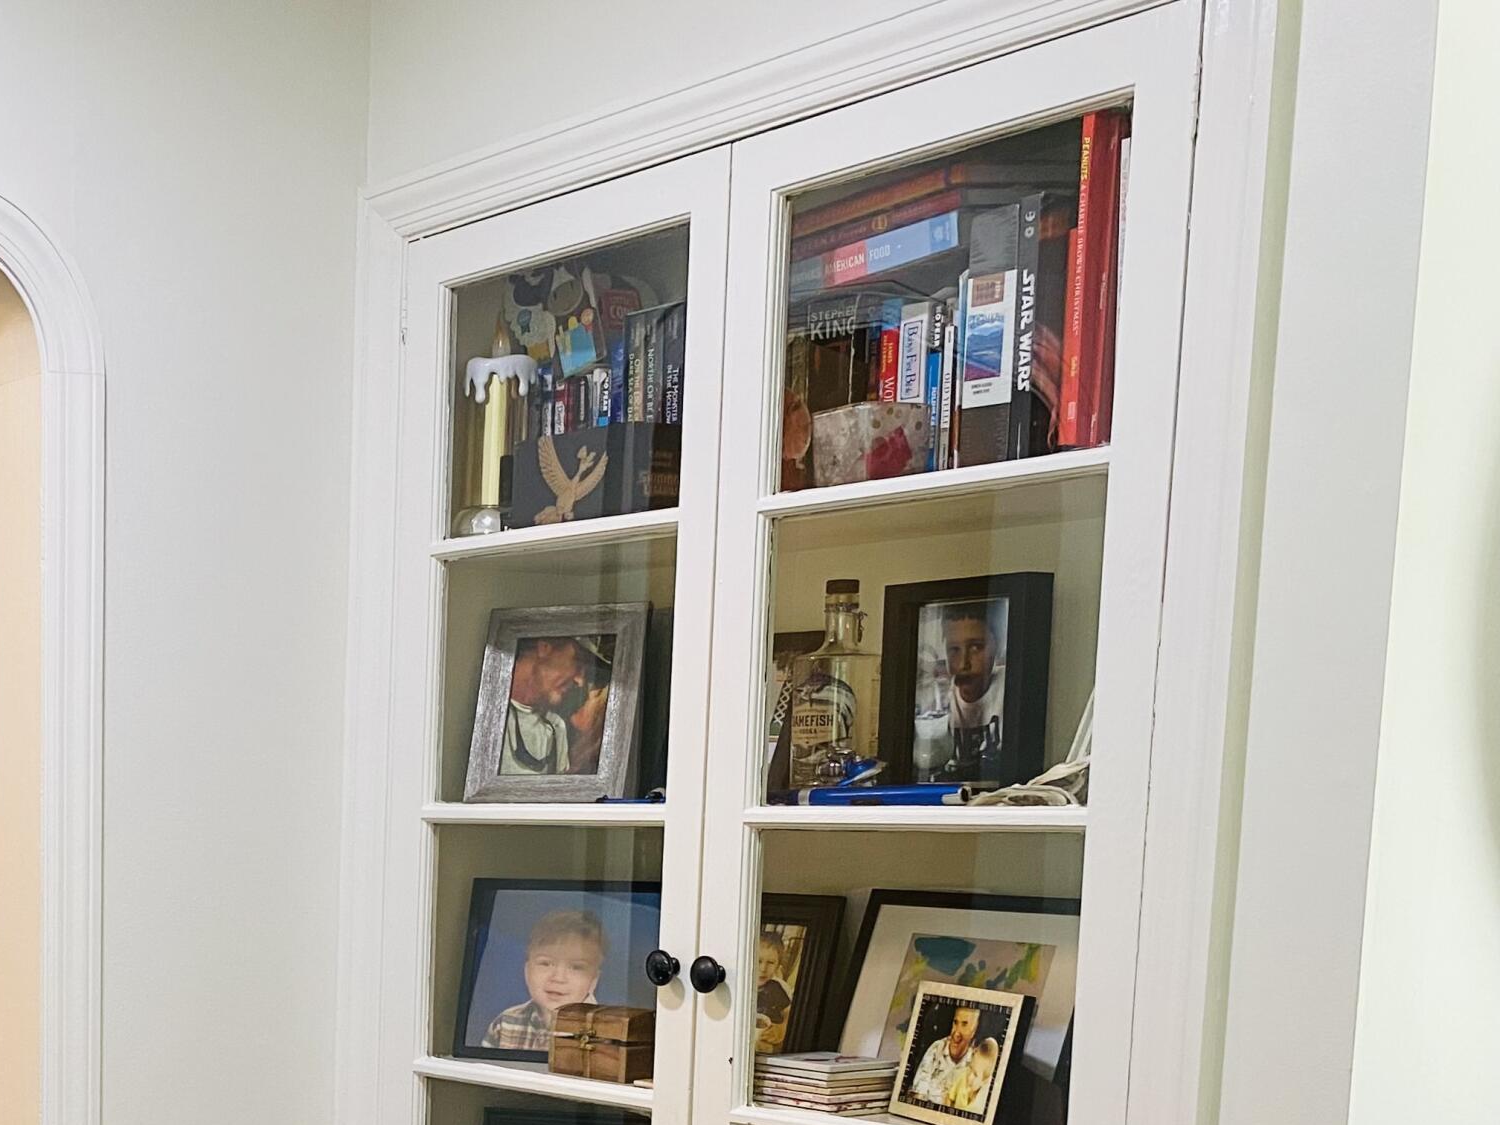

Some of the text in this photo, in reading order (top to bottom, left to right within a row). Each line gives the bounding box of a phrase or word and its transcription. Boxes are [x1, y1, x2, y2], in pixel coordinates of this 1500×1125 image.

[1080, 137, 1091, 180] PEANUTS
[868, 245, 891, 261] FOOD
[810, 316, 855, 341] KING
[933, 322, 941, 348] FEAR
[1017, 269, 1035, 392] STAR WARS
[671, 385, 679, 422] MONSTER
